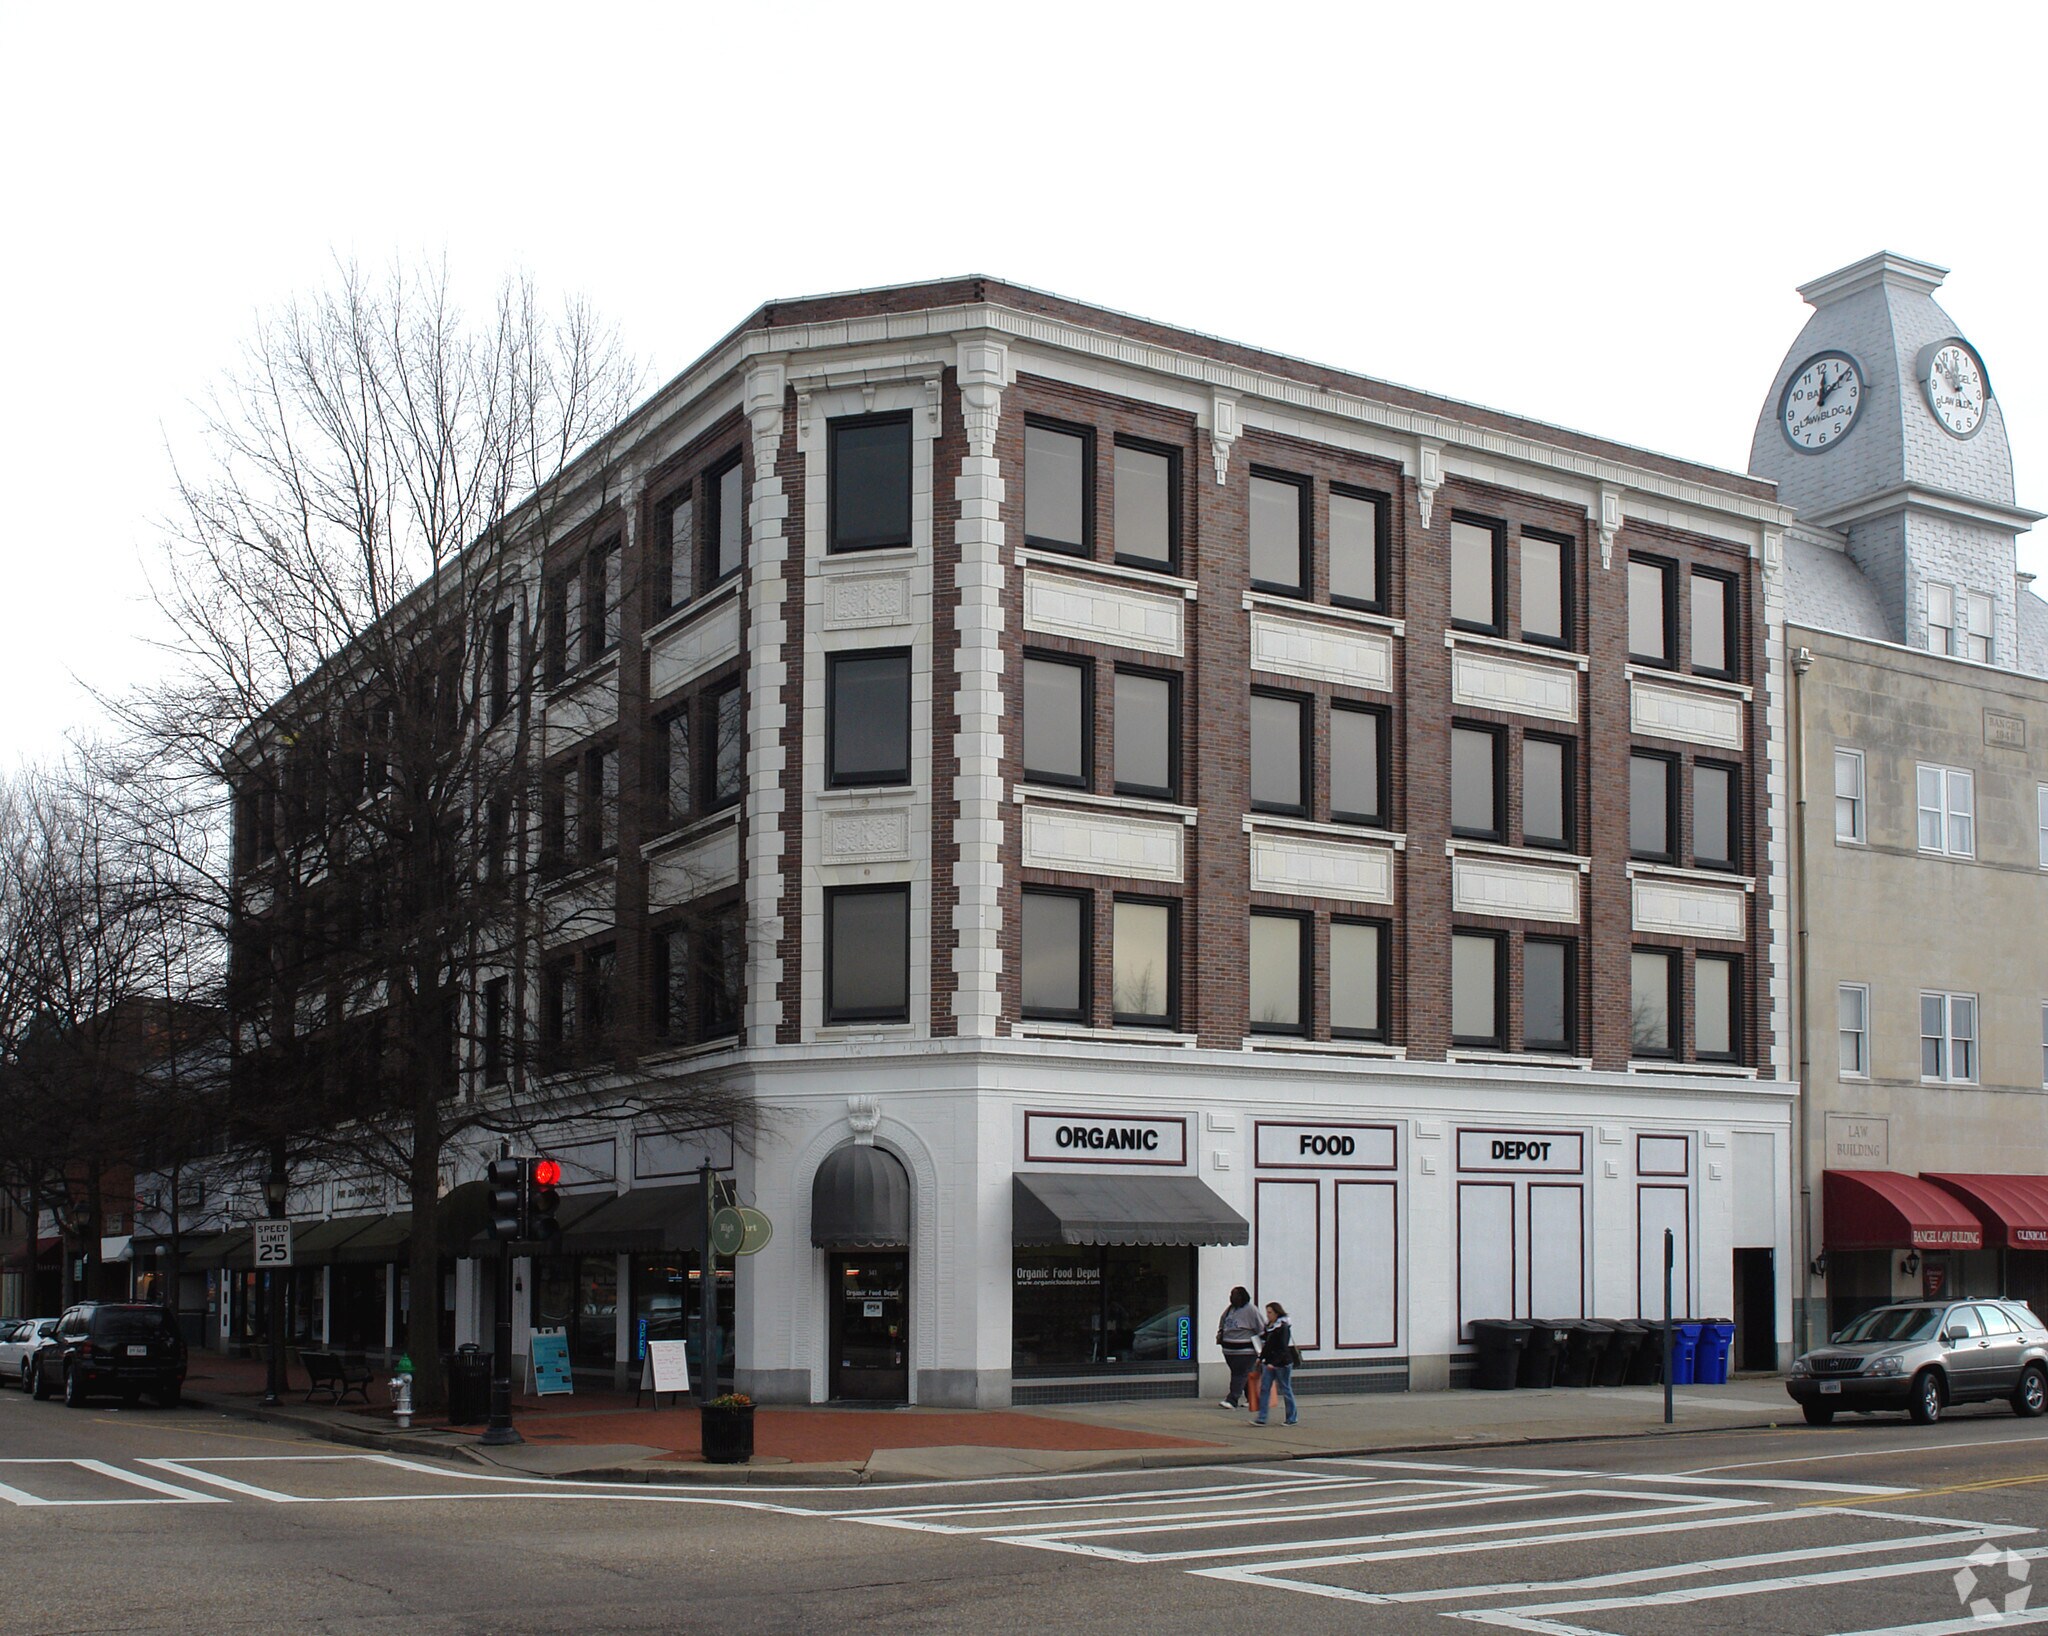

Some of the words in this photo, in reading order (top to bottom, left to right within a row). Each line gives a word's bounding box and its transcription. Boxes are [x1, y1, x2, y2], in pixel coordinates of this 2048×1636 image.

[1816, 363, 1827, 375] 12
[1834, 362, 1839, 373] 1
[1803, 374, 1811, 385] 11
[1972, 372, 1978, 383] 2
[1932, 379, 1938, 390] 9
[1792, 390, 1803, 402] 10
[1850, 386, 1857, 398] 3
[1976, 390, 1982, 400] 3
[1788, 410, 1795, 421] 9
[1845, 406, 1852, 416] 4
[1945, 412, 1950, 423] 7
[1967, 418, 1972, 428] 5
[1793, 425, 1800, 436] 8
[1834, 422, 1841, 433] 5
[1956, 420, 1961, 431] 6
[1805, 433, 1811, 444] 7
[1819, 432, 1826, 443] 6
[1848, 1125, 1868, 1138] LAW
[1055, 1126, 1159, 1151] ORGANIC
[1300, 1135, 1355, 1156] FOOD
[1491, 1140, 1552, 1161] DEPOT
[1837, 1143, 1880, 1157] BUILDING
[257, 1225, 289, 1233] SPEED
[261, 1234, 285, 1242] LIMIT
[1937, 1231, 1951, 1243] LAW
[1952, 1231, 1980, 1244] BUILDING
[259, 1244, 287, 1261] 25
[1016, 1267, 1049, 1280] Organic
[1053, 1267, 1073, 1279] Food
[1076, 1267, 1100, 1280] Depot
[1180, 1319, 1188, 1357] OPEN
